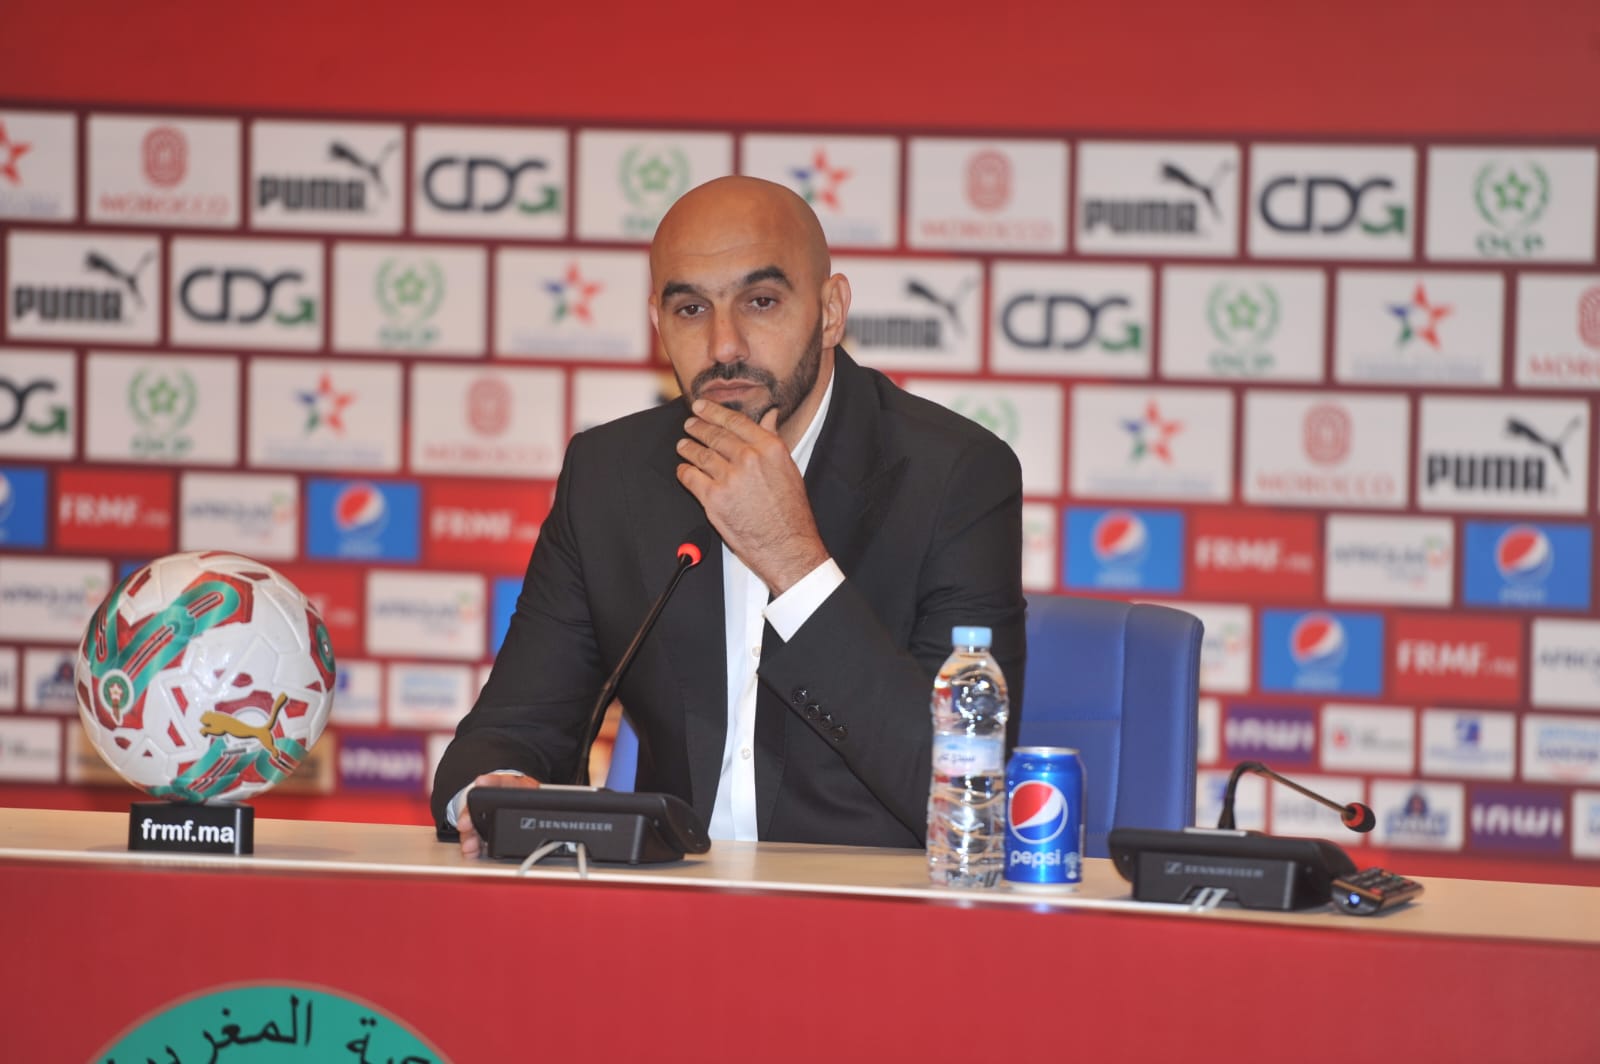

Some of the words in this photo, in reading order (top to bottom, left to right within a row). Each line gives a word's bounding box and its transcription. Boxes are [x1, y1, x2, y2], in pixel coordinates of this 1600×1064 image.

[257, 175, 367, 212] PUMA
[423, 157, 560, 215] CDG
[1084, 199, 1198, 236] PUMA
[1259, 176, 1406, 235] CDG
[13, 286, 123, 323] PUMA
[180, 267, 317, 325] CDG
[1002, 292, 1142, 351] CDG
[1426, 453, 1547, 492] PUMA
[141, 818, 235, 844] frmf.ma
[538, 819, 613, 832] SENNHEISER
[1010, 848, 1061, 869] pepsi
